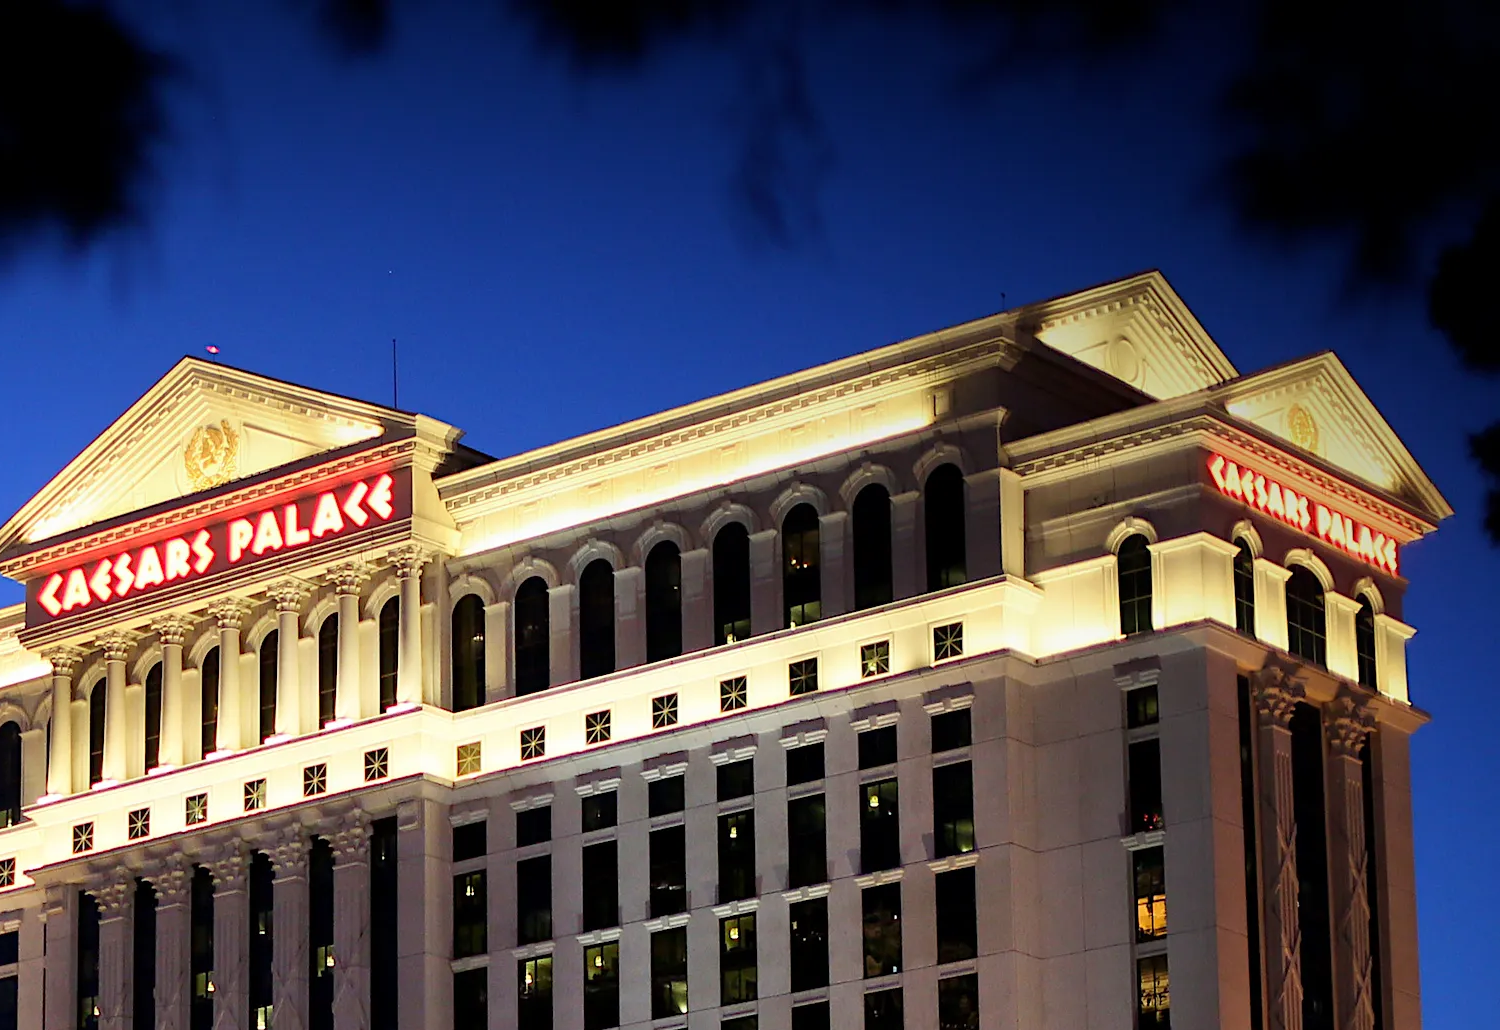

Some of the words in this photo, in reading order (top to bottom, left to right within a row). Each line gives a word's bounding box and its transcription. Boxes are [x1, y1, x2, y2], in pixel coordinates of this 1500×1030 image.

[38, 529, 216, 617] CAESARS
[228, 474, 395, 564] PALACE
[1208, 455, 1313, 532] CAESARS
[1316, 503, 1398, 575] PALACE
